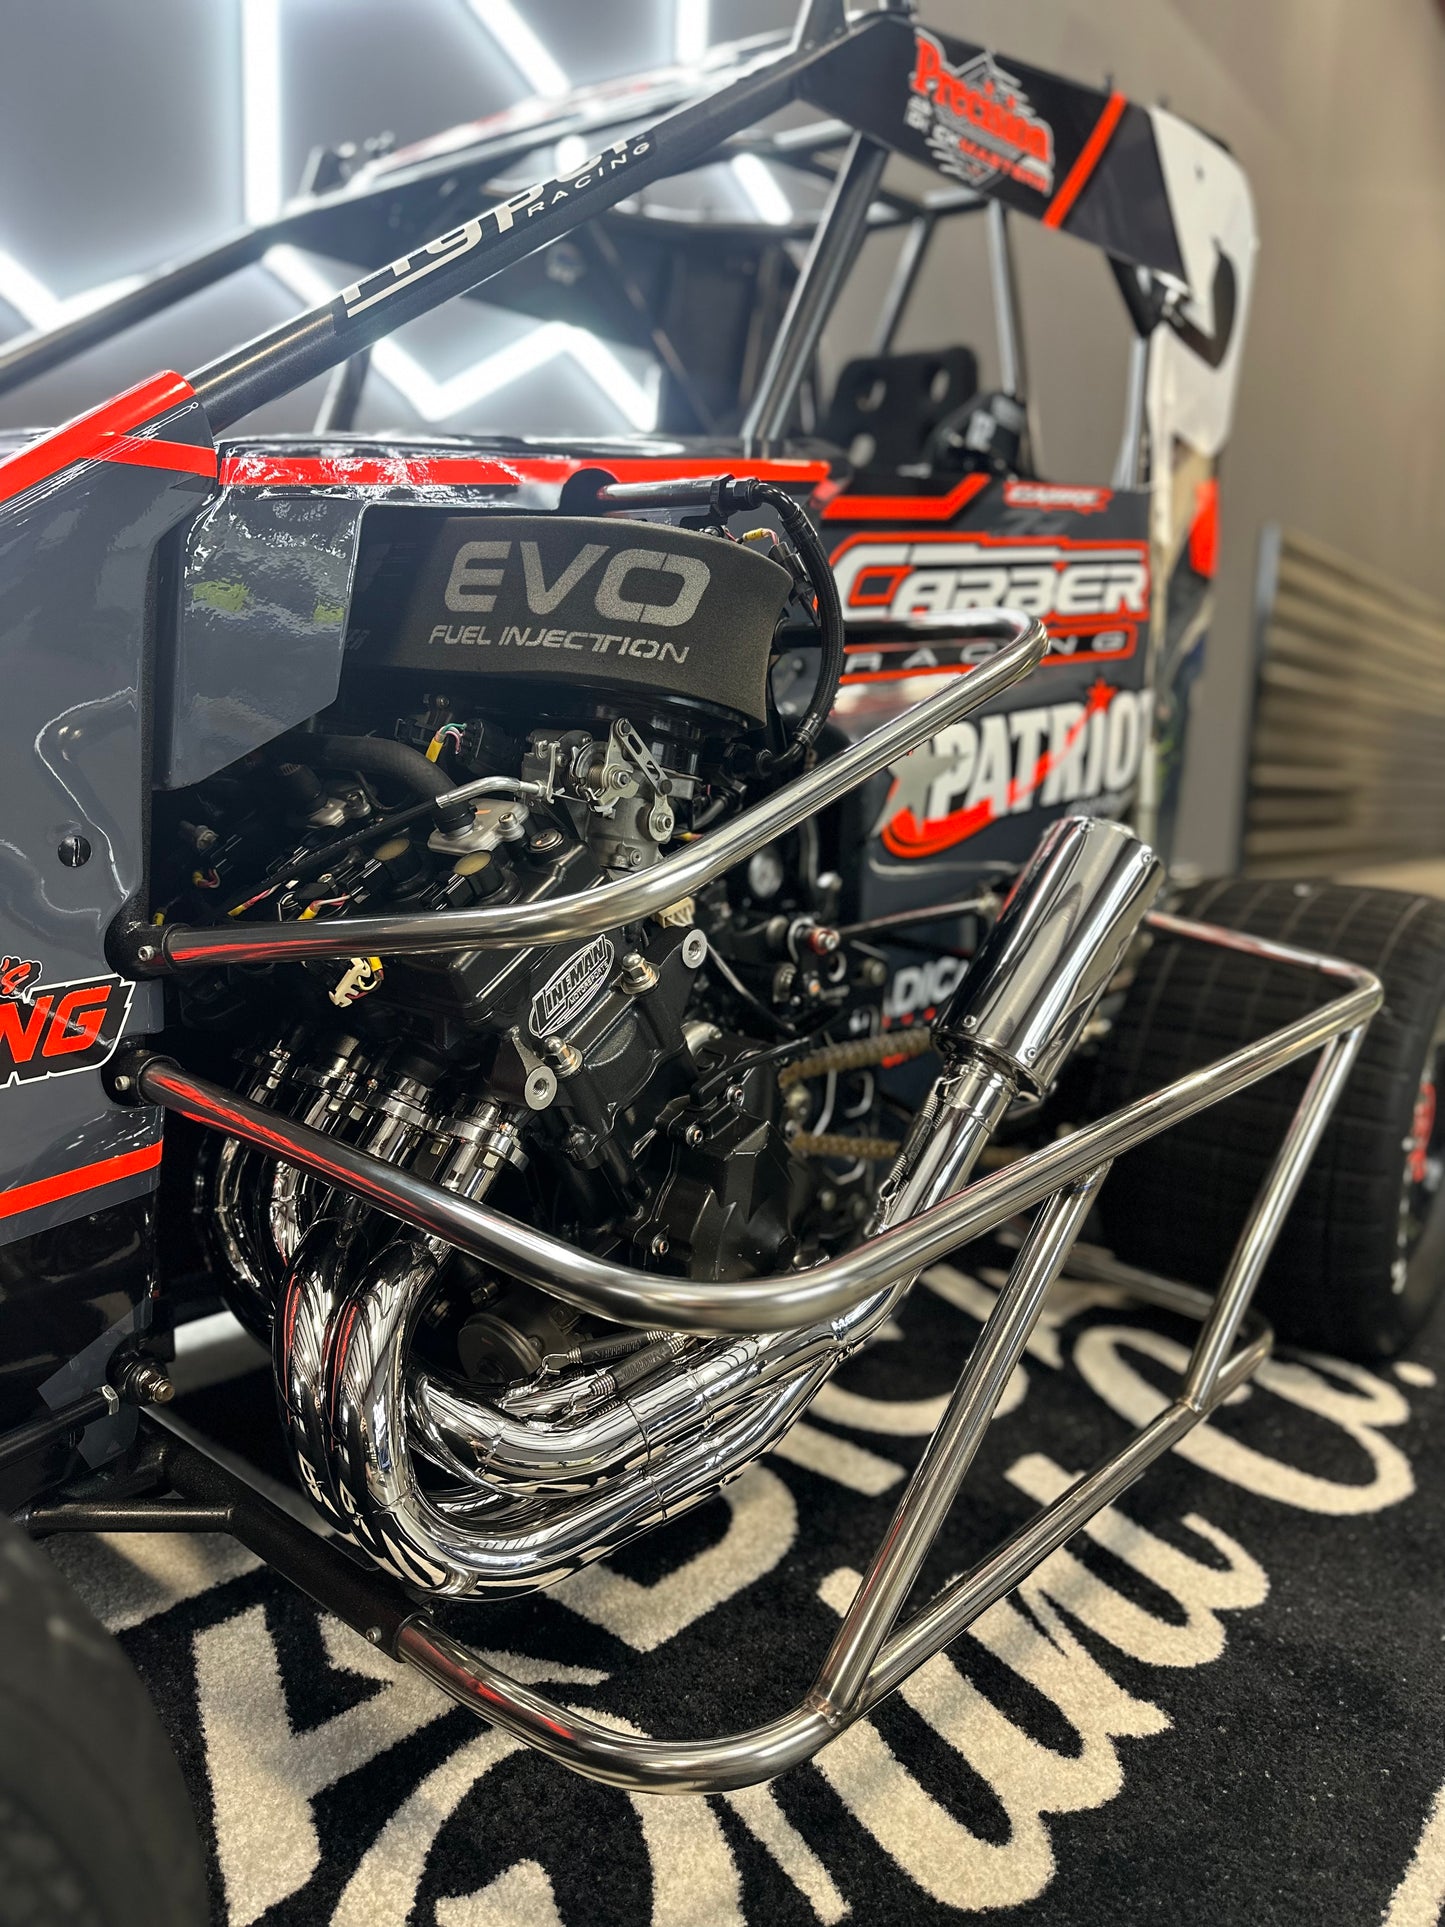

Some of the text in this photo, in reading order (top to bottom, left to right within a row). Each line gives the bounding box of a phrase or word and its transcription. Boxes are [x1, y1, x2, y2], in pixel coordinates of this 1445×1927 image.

[527, 141, 650, 218] RACING
[444, 541, 711, 627] EVO
[832, 542, 1149, 622] CARBER
[428, 625, 690, 664] FUEL INJECTION
[845, 631, 1127, 674] RACNG
[532, 934, 609, 1037] LINEMAN
